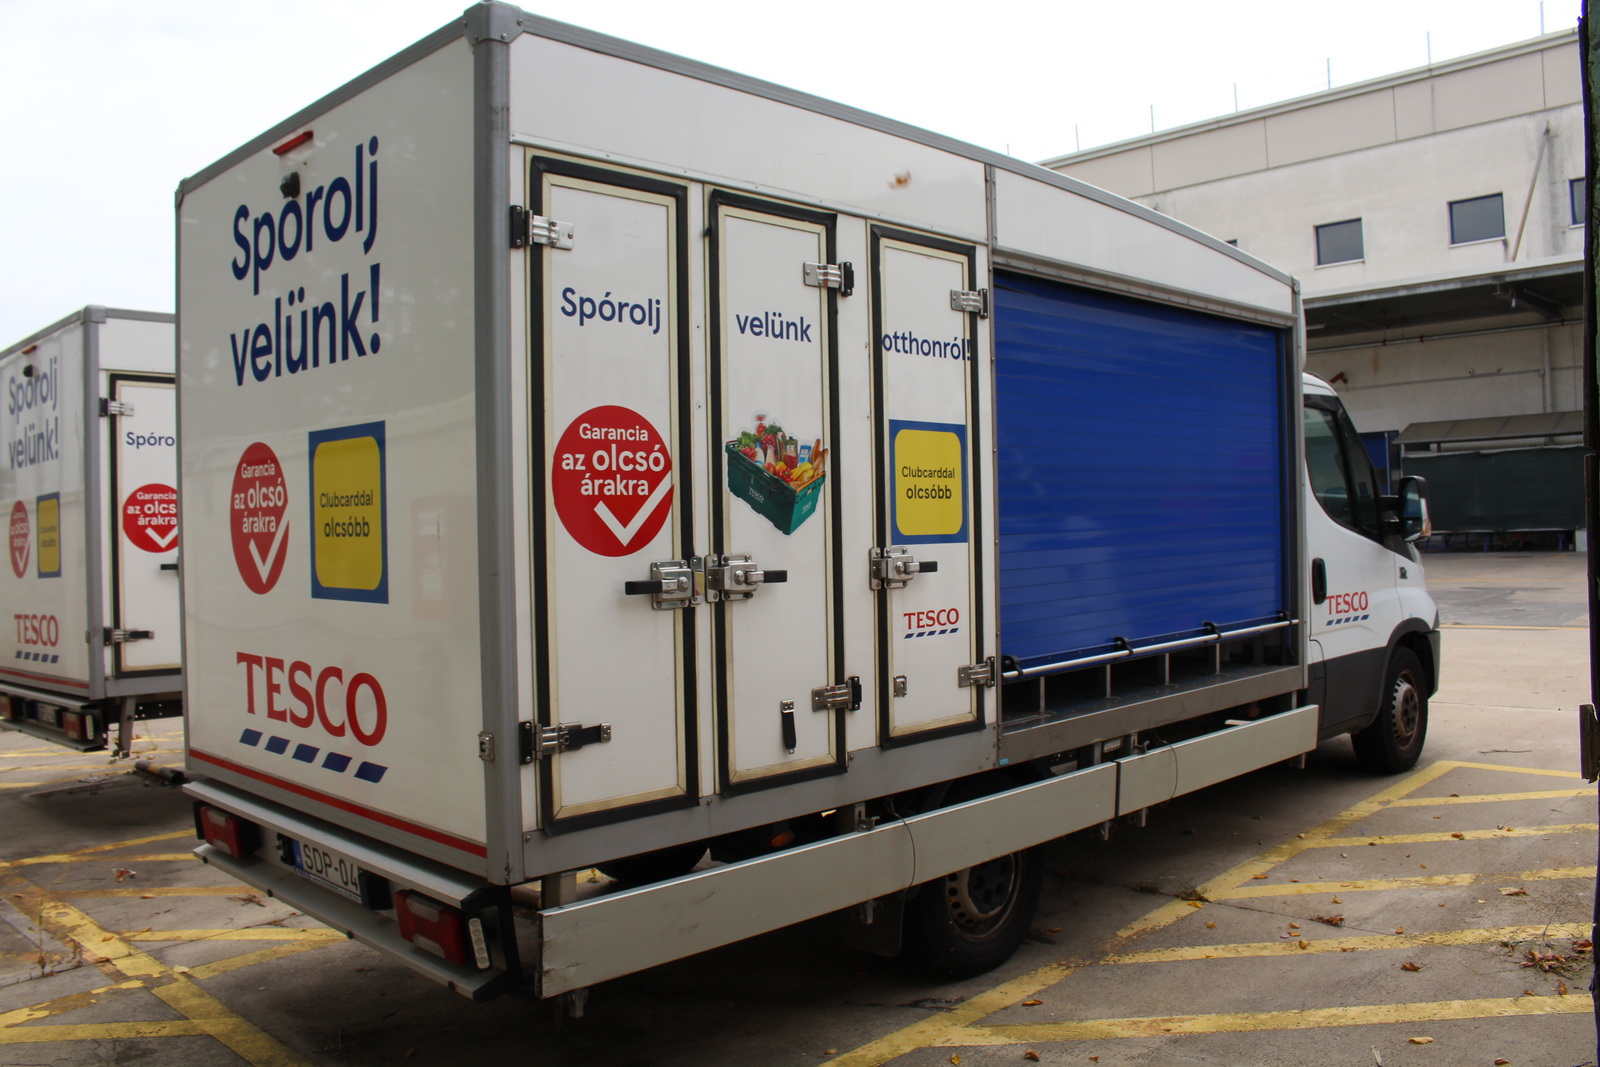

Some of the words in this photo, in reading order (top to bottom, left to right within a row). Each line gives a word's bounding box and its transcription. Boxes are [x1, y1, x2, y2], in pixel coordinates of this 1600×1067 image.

[230, 262, 381, 387] velünk!
[560, 287, 661, 335] Spórolj
[736, 311, 812, 342] velünk
[882, 331, 971, 361] otthonról!
[8, 416, 58, 470] velünk!
[126, 431, 176, 449] Spóro
[579, 423, 649, 442] Garancia
[241, 460, 276, 478] Garancia
[561, 451, 586, 470] az
[592, 444, 665, 472] olcsó
[901, 466, 956, 478] Clubcarddal
[136, 491, 177, 500] Garancia
[234, 493, 246, 509] az
[247, 477, 285, 509] olcsó
[580, 473, 649, 496] árakra
[906, 484, 952, 499] olcsóbb
[127, 505, 141, 514] az
[144, 501, 177, 514] olcs
[320, 489, 374, 508] Clubcarddal
[137, 514, 177, 526] árakra
[242, 511, 277, 533] árakra
[324, 515, 370, 538] olcsóbb
[1325, 591, 1369, 615] TESCO
[904, 608, 960, 630] TESCO
[14, 614, 59, 647] TESCO
[236, 651, 388, 747] TESCO
[303, 843, 363, 891] SDP-04
